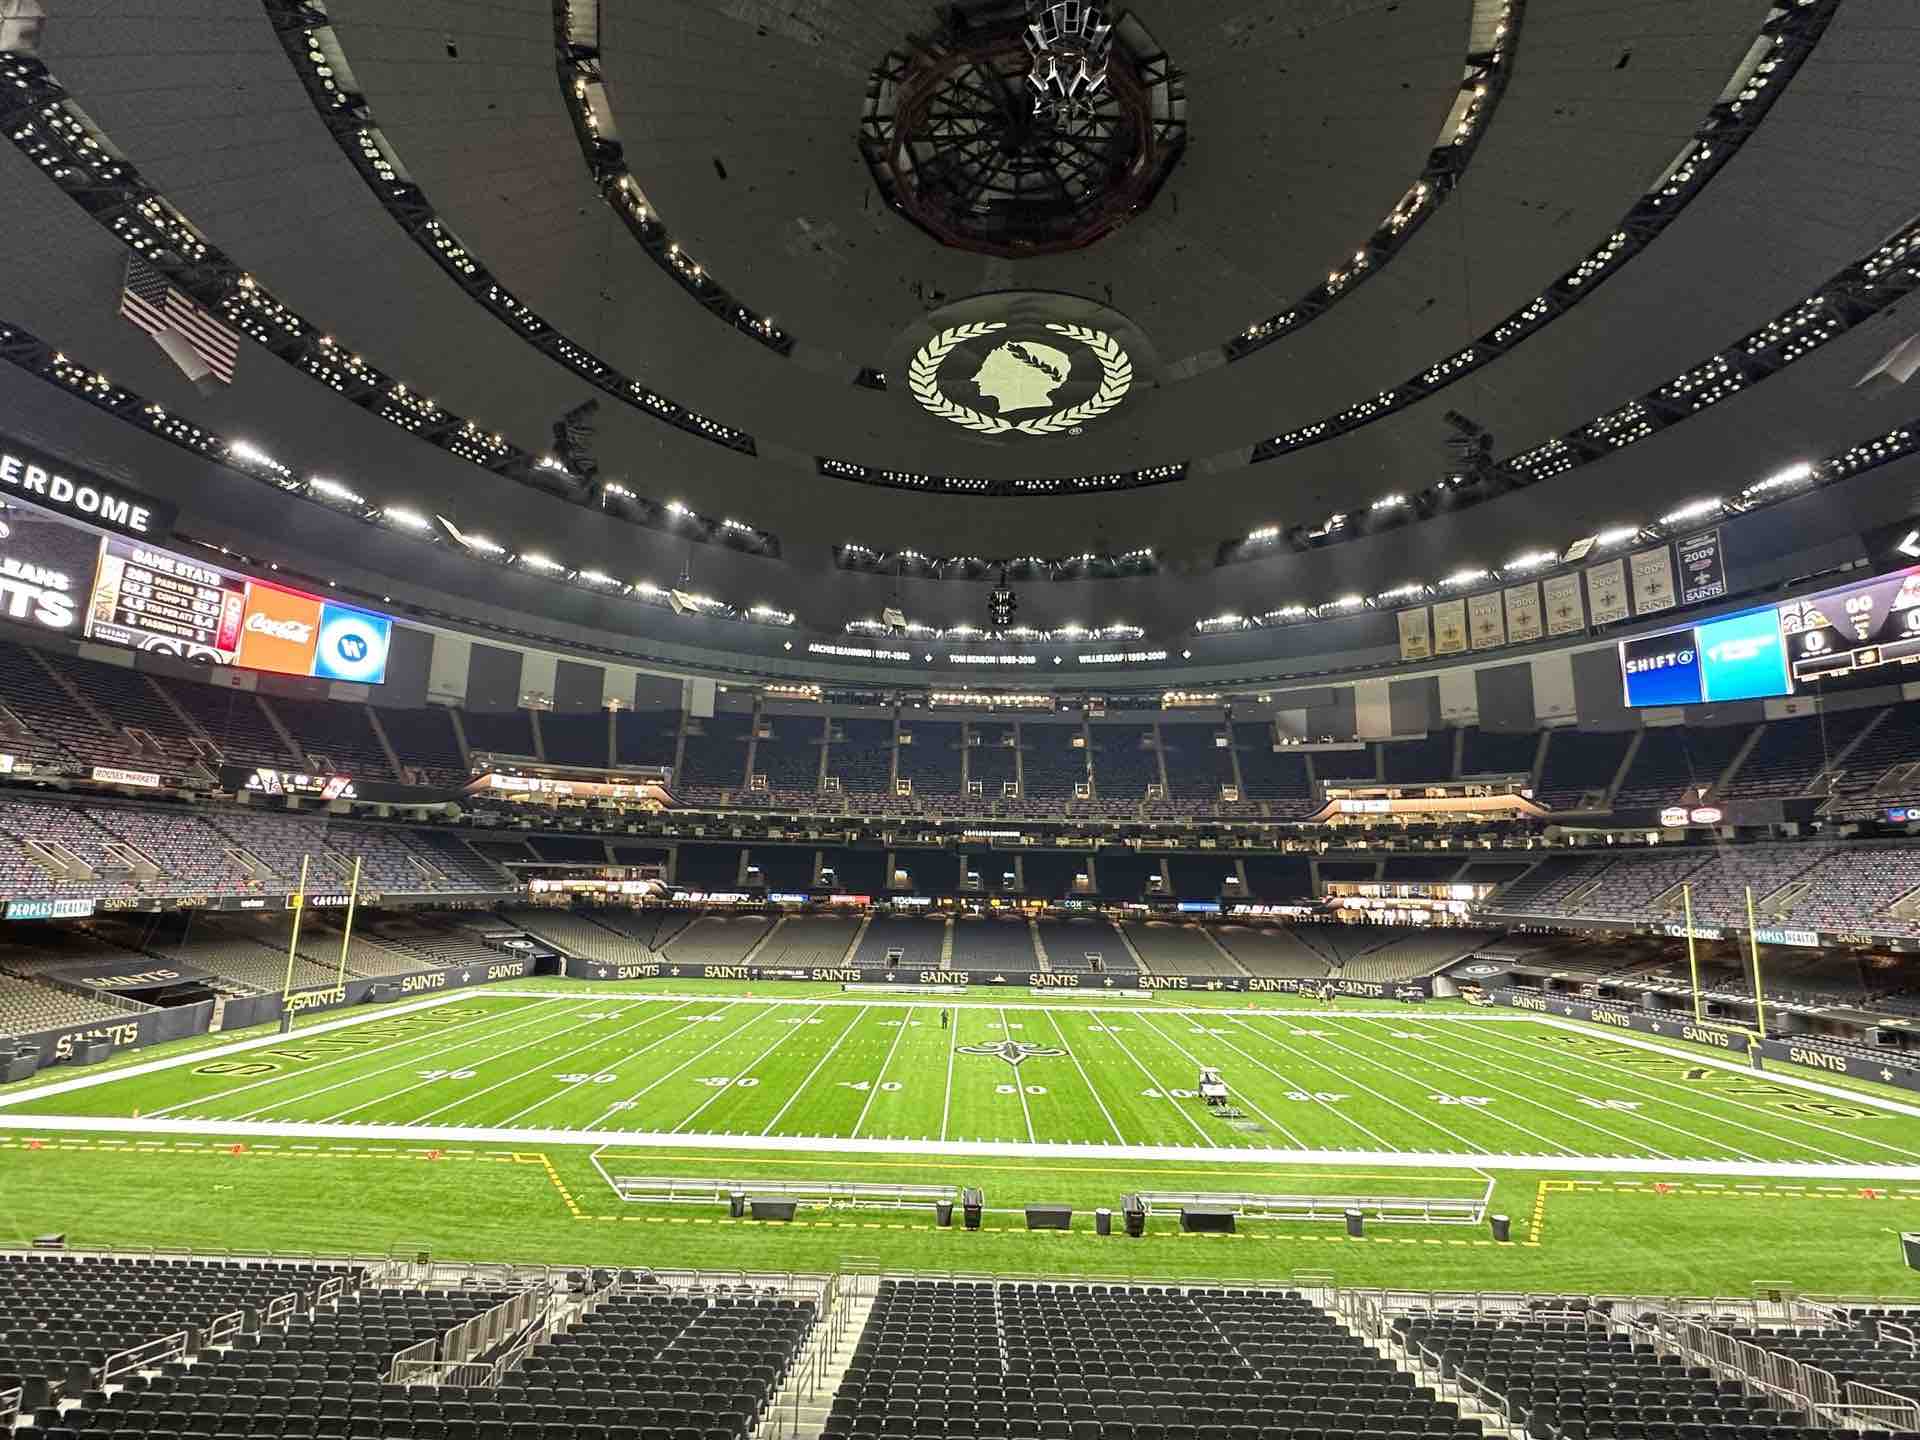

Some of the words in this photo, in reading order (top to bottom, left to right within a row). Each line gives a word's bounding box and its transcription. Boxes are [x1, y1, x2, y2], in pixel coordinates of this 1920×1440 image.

[1684, 547, 1714, 563] 2009
[132, 549, 176, 574] GAME
[175, 563, 221, 586] STATS
[1686, 586, 1723, 602] SAINTS
[103, 898, 138, 911] SAINTS
[176, 896, 208, 908] SAINTS
[9, 903, 52, 917] PEOPLES
[1837, 934, 1872, 945] SAINTS
[486, 962, 523, 979] SAINTS
[617, 965, 659, 979] SAINTS
[812, 969, 861, 981] SAINTS
[919, 971, 969, 984] SAINTS
[82, 968, 179, 988] SAINTS
[402, 972, 445, 992] SAINTS
[1029, 974, 1079, 987] SAINTS
[1138, 977, 1188, 989] SAINTS
[1249, 979, 1299, 992] SAINTS
[1338, 980, 1383, 996] SAINTS
[1512, 995, 1546, 1010] SAINTS
[1591, 1009, 1630, 1026] SAINTS
[1683, 1026, 1728, 1047] SAINTS
[1790, 1047, 1847, 1072] SAINTS
[995, 1085, 1047, 1095] 50
